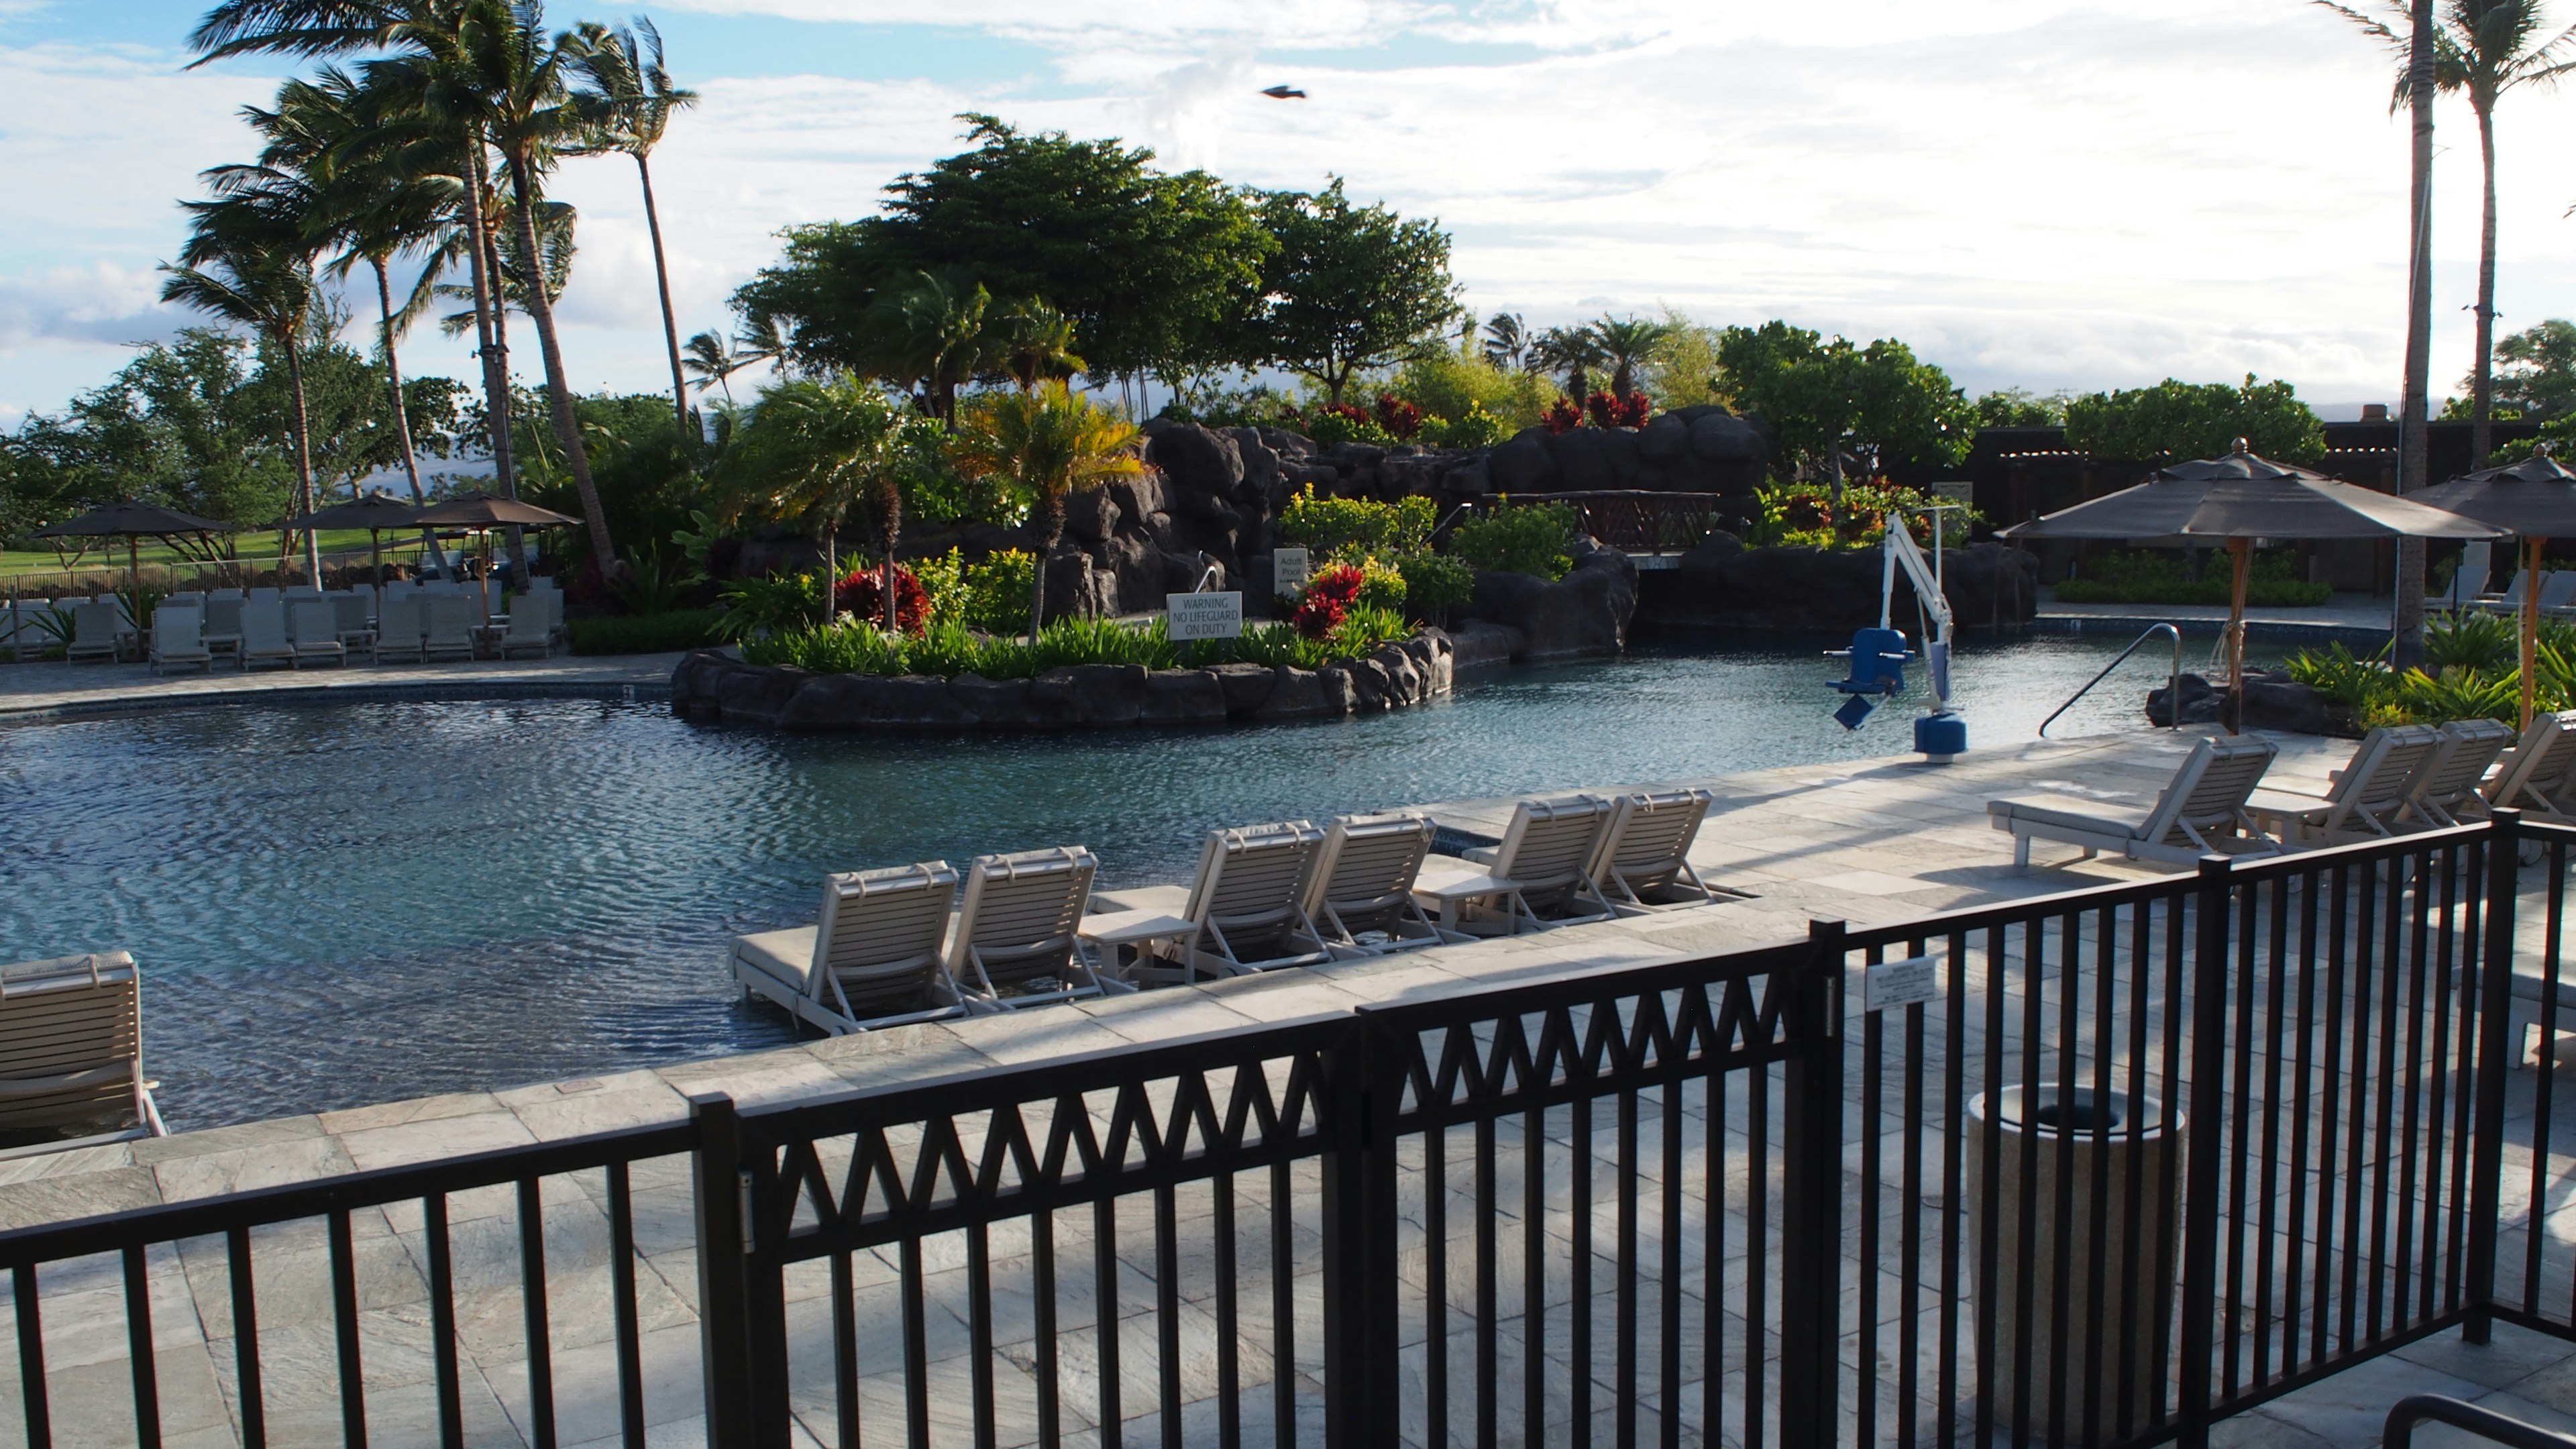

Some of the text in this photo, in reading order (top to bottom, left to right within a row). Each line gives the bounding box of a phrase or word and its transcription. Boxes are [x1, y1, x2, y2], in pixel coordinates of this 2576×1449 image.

[1183, 598, 1228, 610] WARNING
[1173, 610, 1238, 623] NO LIFEGUARD
[1185, 623, 1227, 635] ON DUTY
